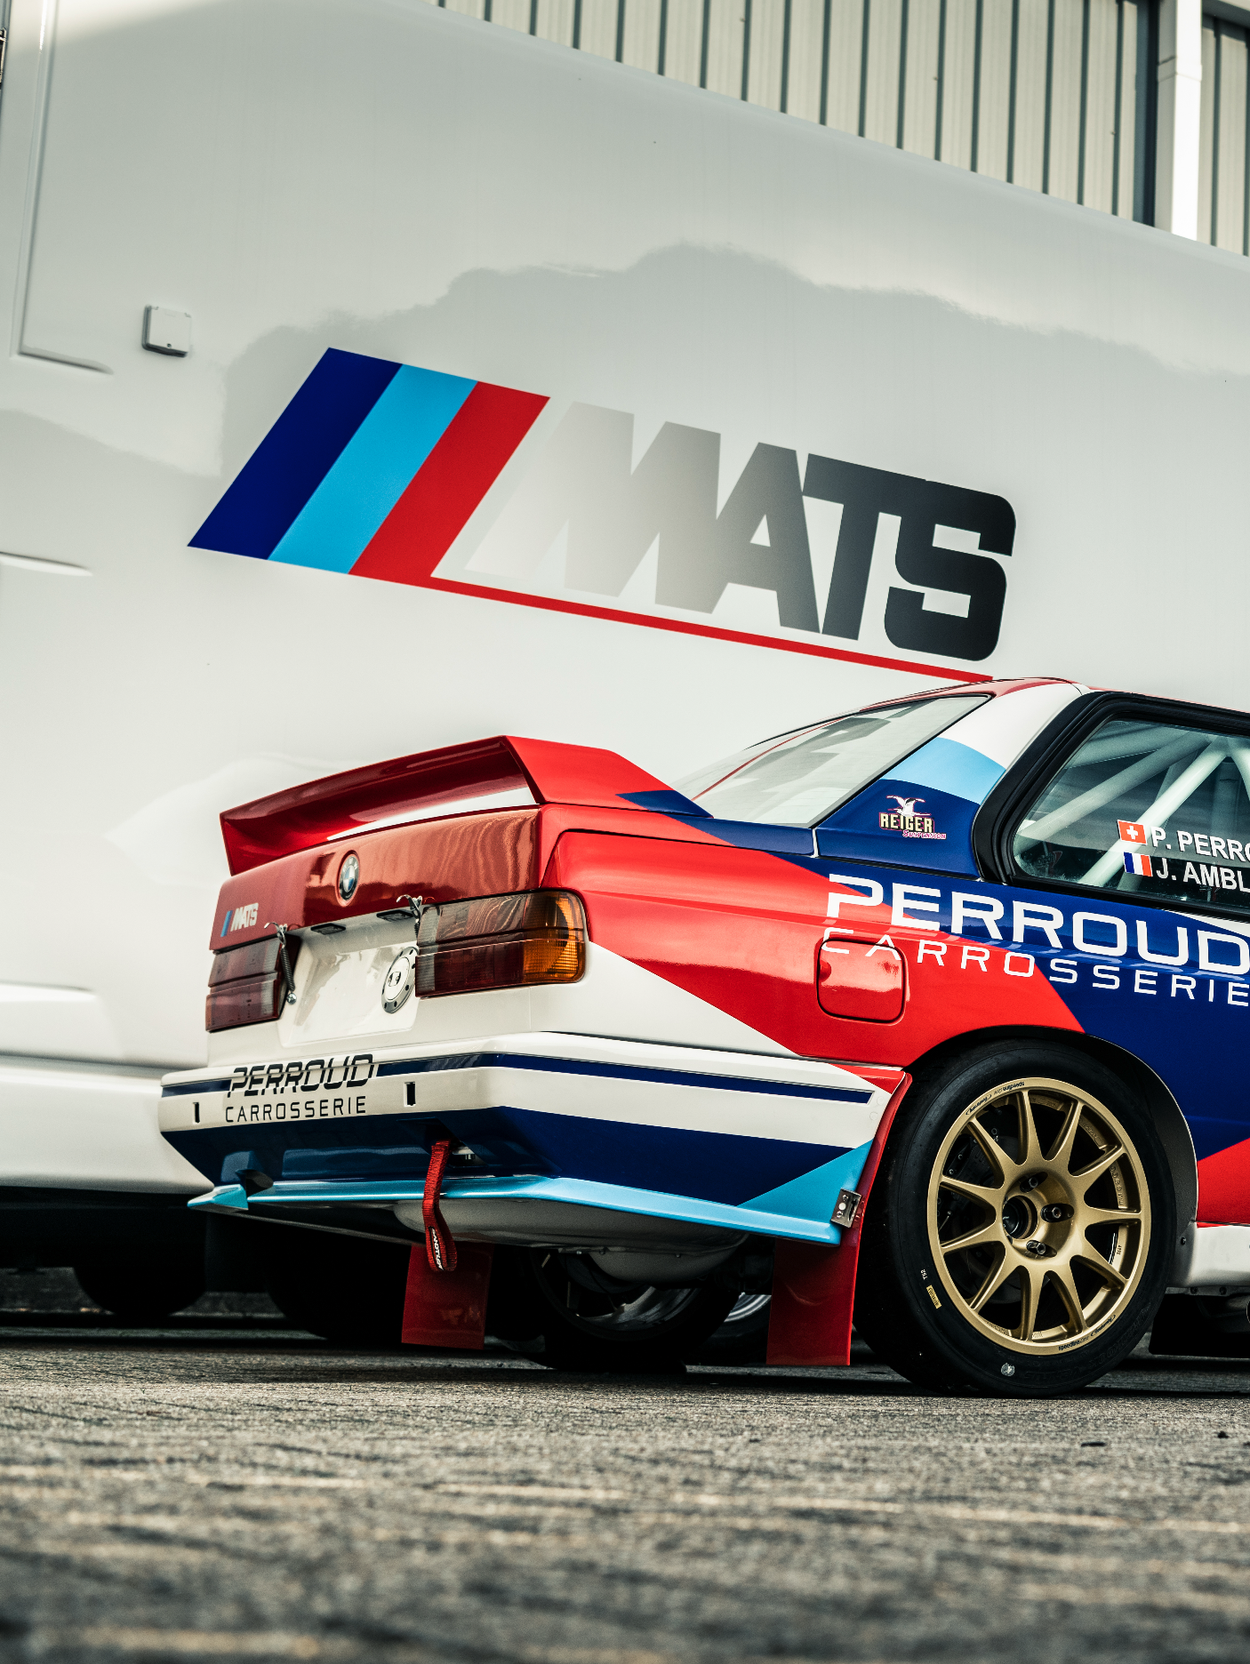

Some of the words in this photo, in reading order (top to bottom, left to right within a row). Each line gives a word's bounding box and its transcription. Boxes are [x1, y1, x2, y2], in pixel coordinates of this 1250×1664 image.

[465, 401, 1016, 662] MATS
[880, 813, 933, 833] REIGER
[1150, 826, 1173, 850] P.
[1155, 858, 1177, 881] J.
[230, 902, 259, 932] MATS
[827, 873, 1250, 976] PERROUD
[823, 928, 1250, 1007] CARROSSERIE
[227, 1054, 374, 1098] PERROUD
[225, 1096, 366, 1122] CARROSSERIE
